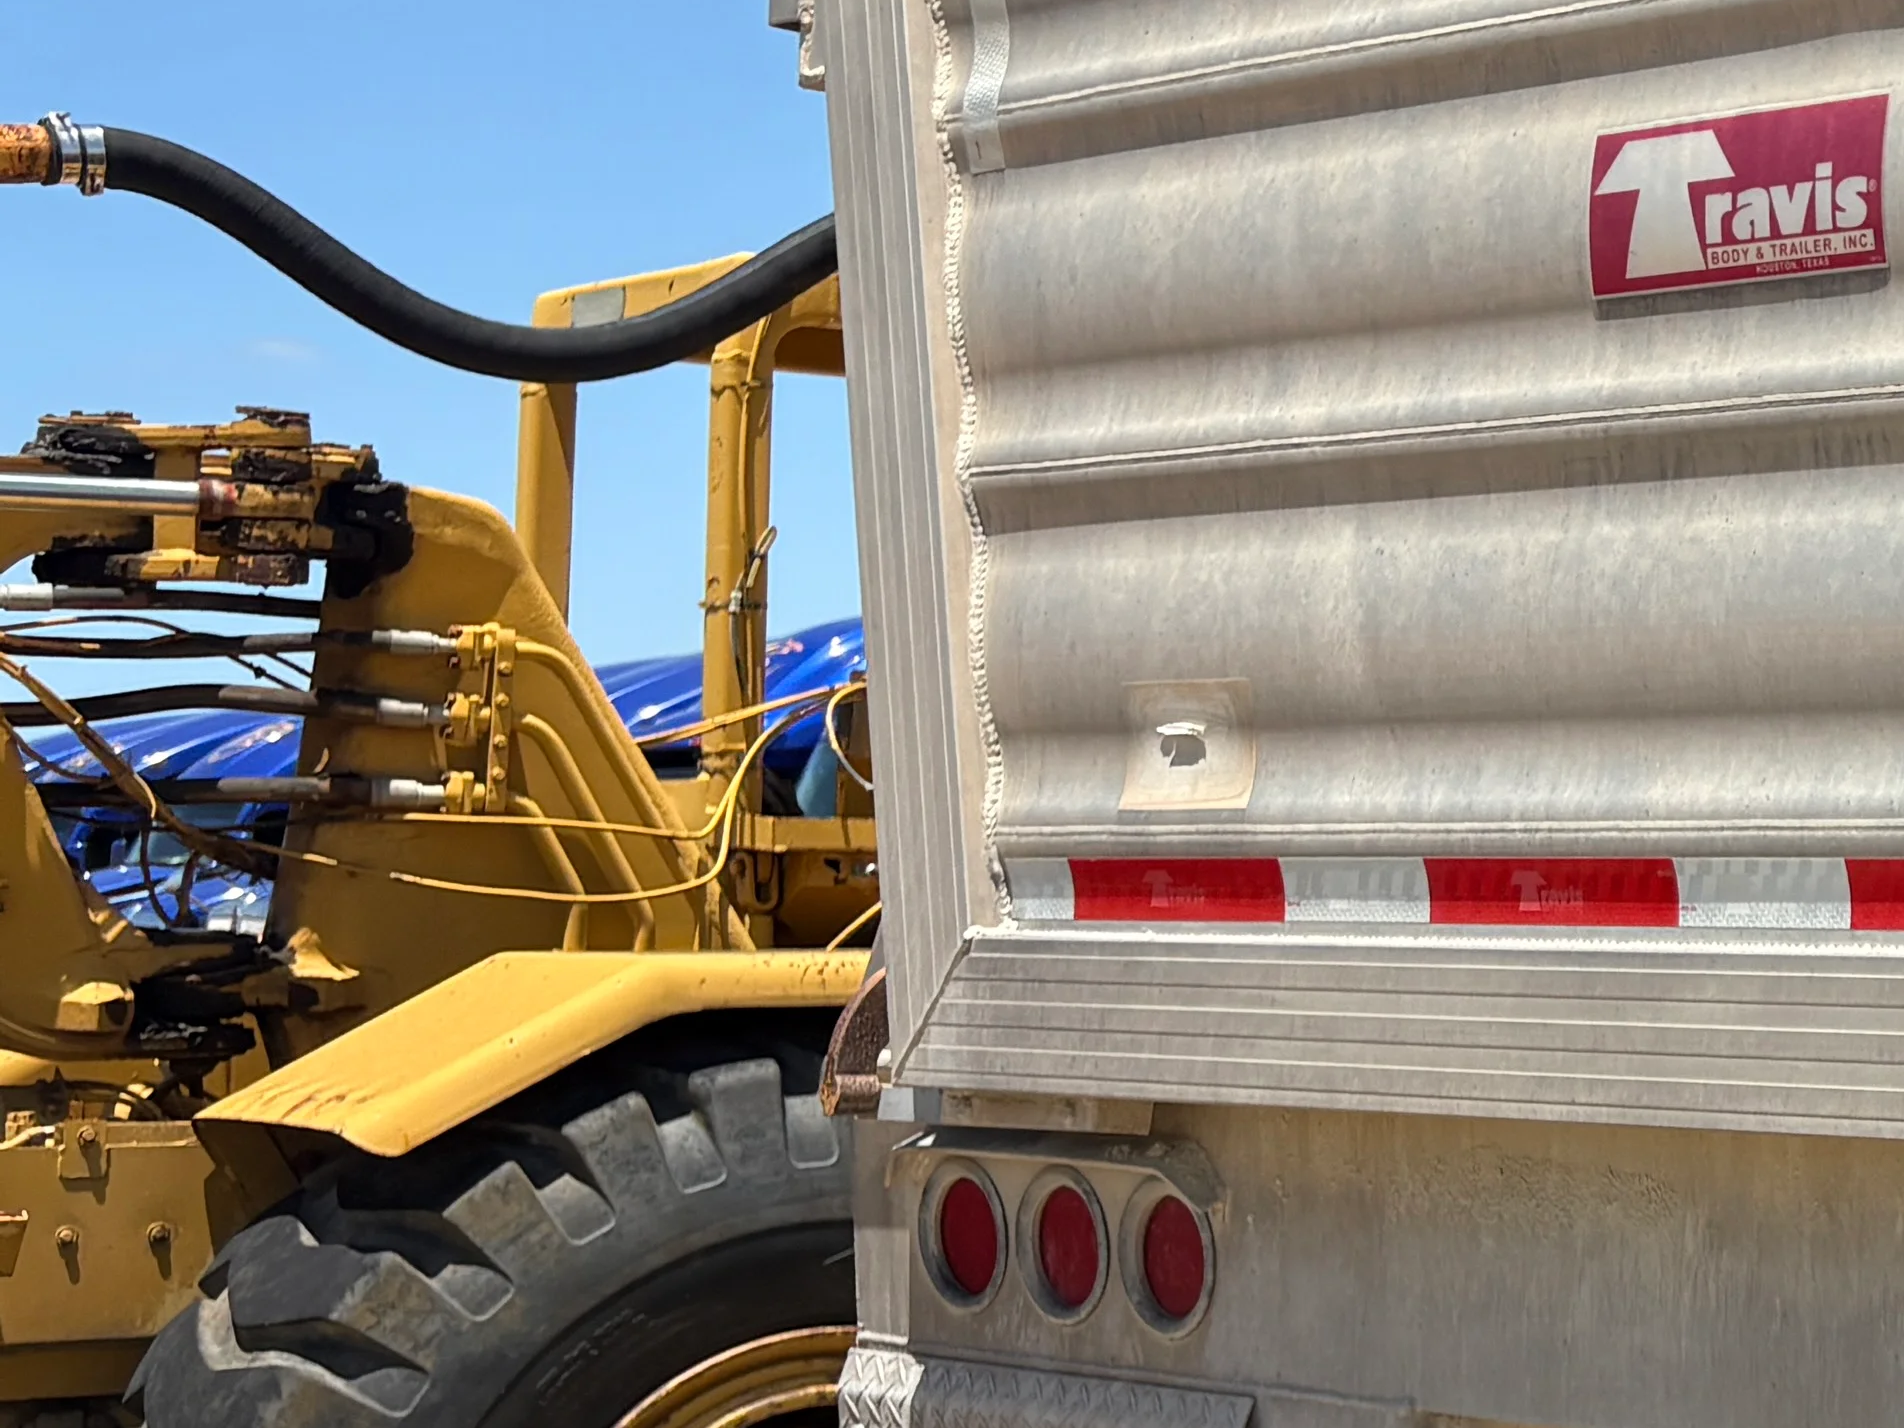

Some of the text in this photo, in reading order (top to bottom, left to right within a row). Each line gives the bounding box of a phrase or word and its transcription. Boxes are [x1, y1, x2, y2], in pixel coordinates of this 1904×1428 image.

[1594, 129, 1868, 279] Travis
[1710, 233, 1874, 265] BODY & TRAILER, INC.
